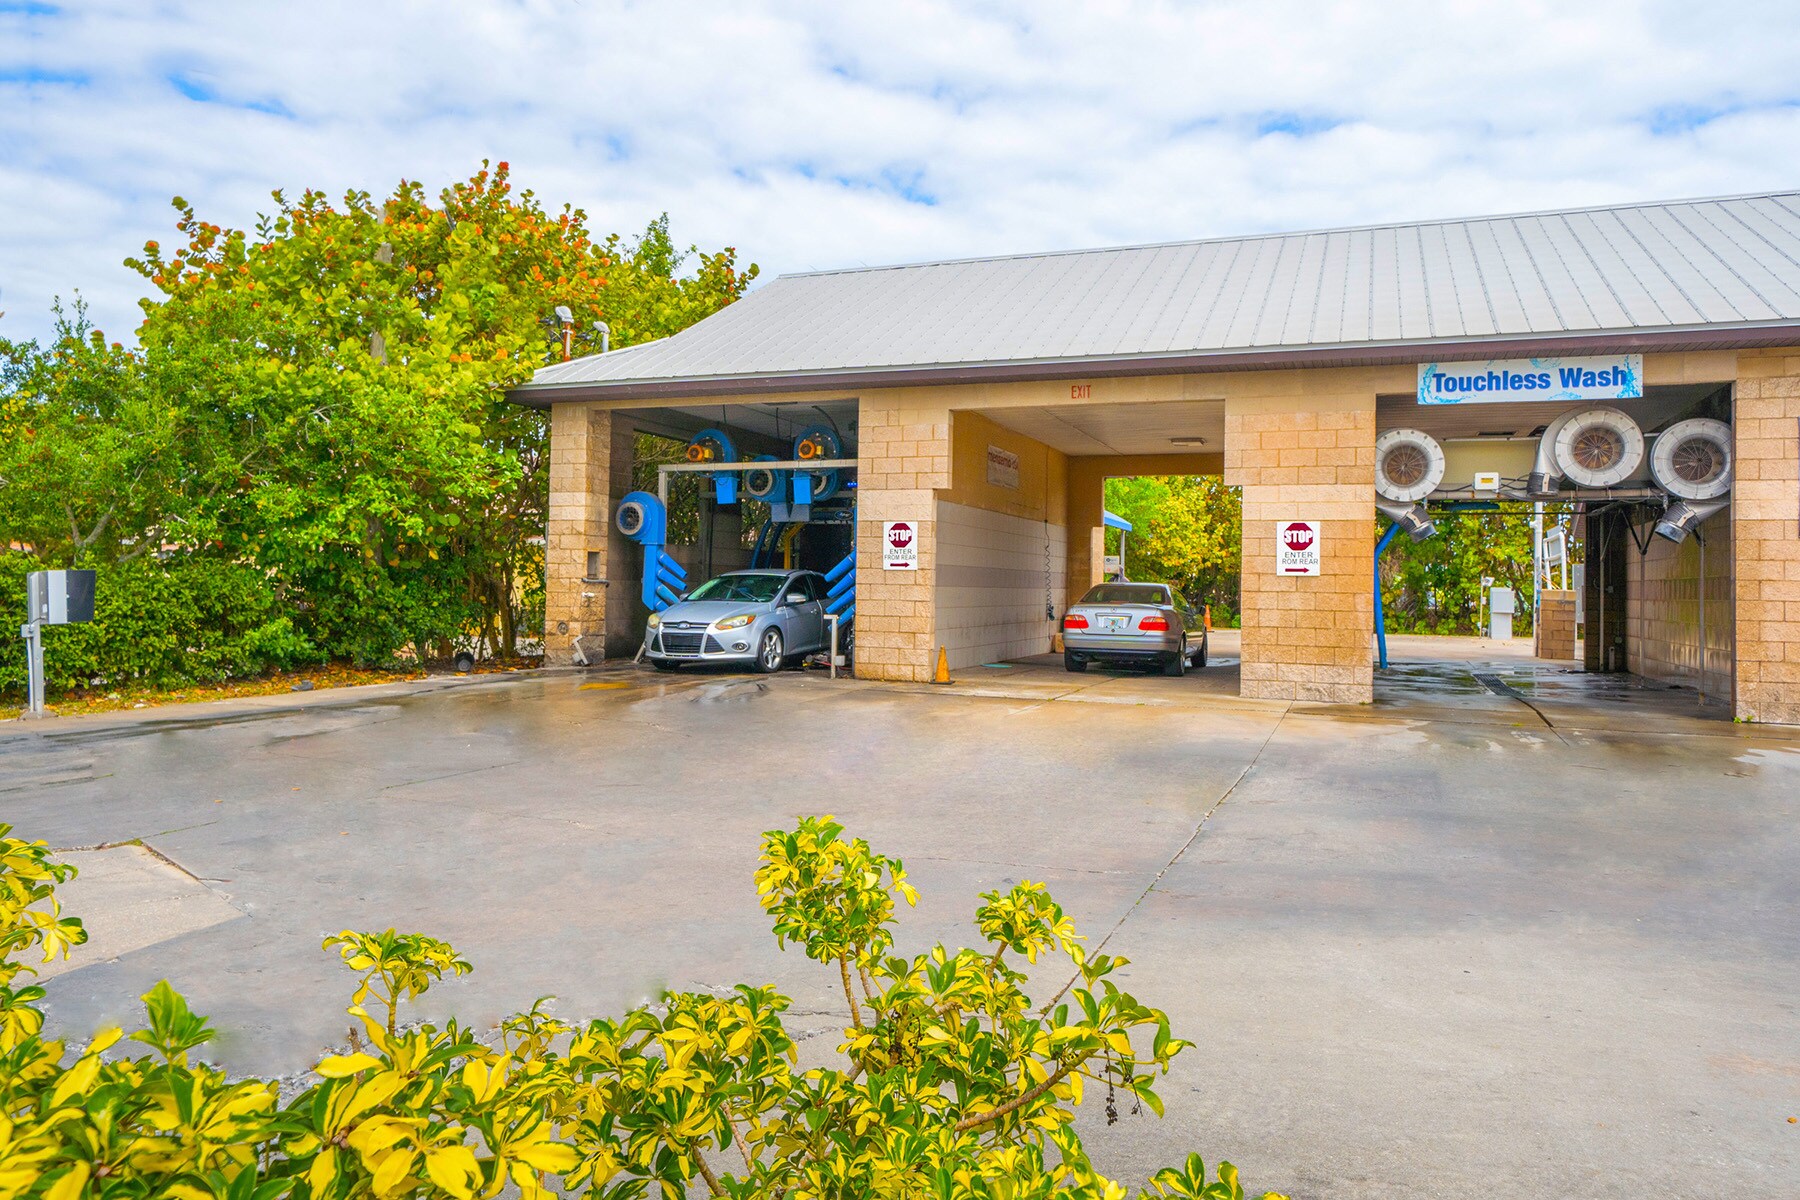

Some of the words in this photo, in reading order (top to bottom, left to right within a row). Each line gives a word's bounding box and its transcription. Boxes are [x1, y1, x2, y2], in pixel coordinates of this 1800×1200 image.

[1432, 370, 1551, 393] Touchless
[1559, 366, 1627, 388] Wash
[1071, 384, 1091, 399] EXIT
[889, 529, 912, 541] STOP
[1284, 530, 1313, 543] STOP
